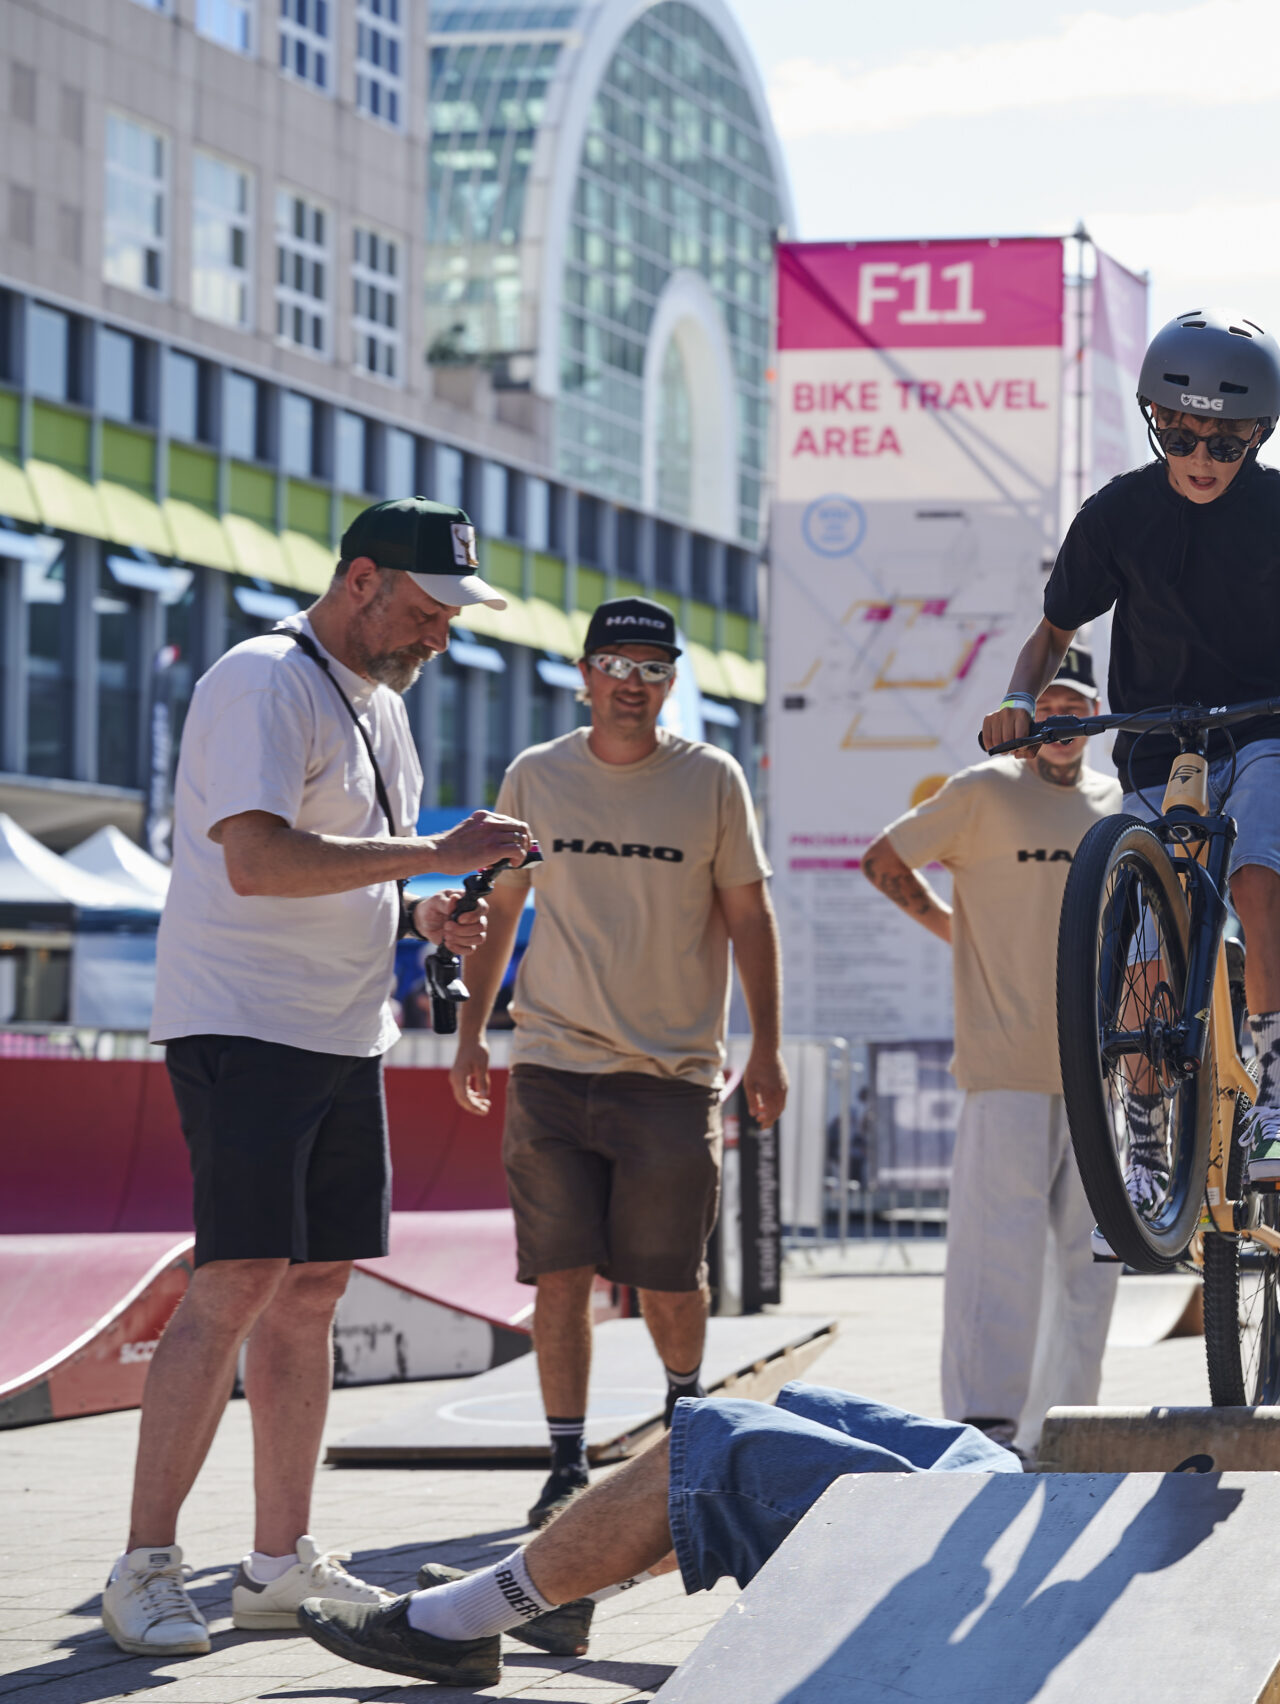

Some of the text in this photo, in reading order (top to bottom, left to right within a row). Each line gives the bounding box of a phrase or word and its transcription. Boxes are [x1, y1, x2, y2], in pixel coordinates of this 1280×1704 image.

[858, 261, 985, 325] F11
[792, 379, 1048, 413] BIKE TRAVEL
[791, 425, 902, 458] AREA
[605, 615, 667, 630] HARO
[552, 838, 684, 863] HARO
[1017, 848, 1074, 863] HA
